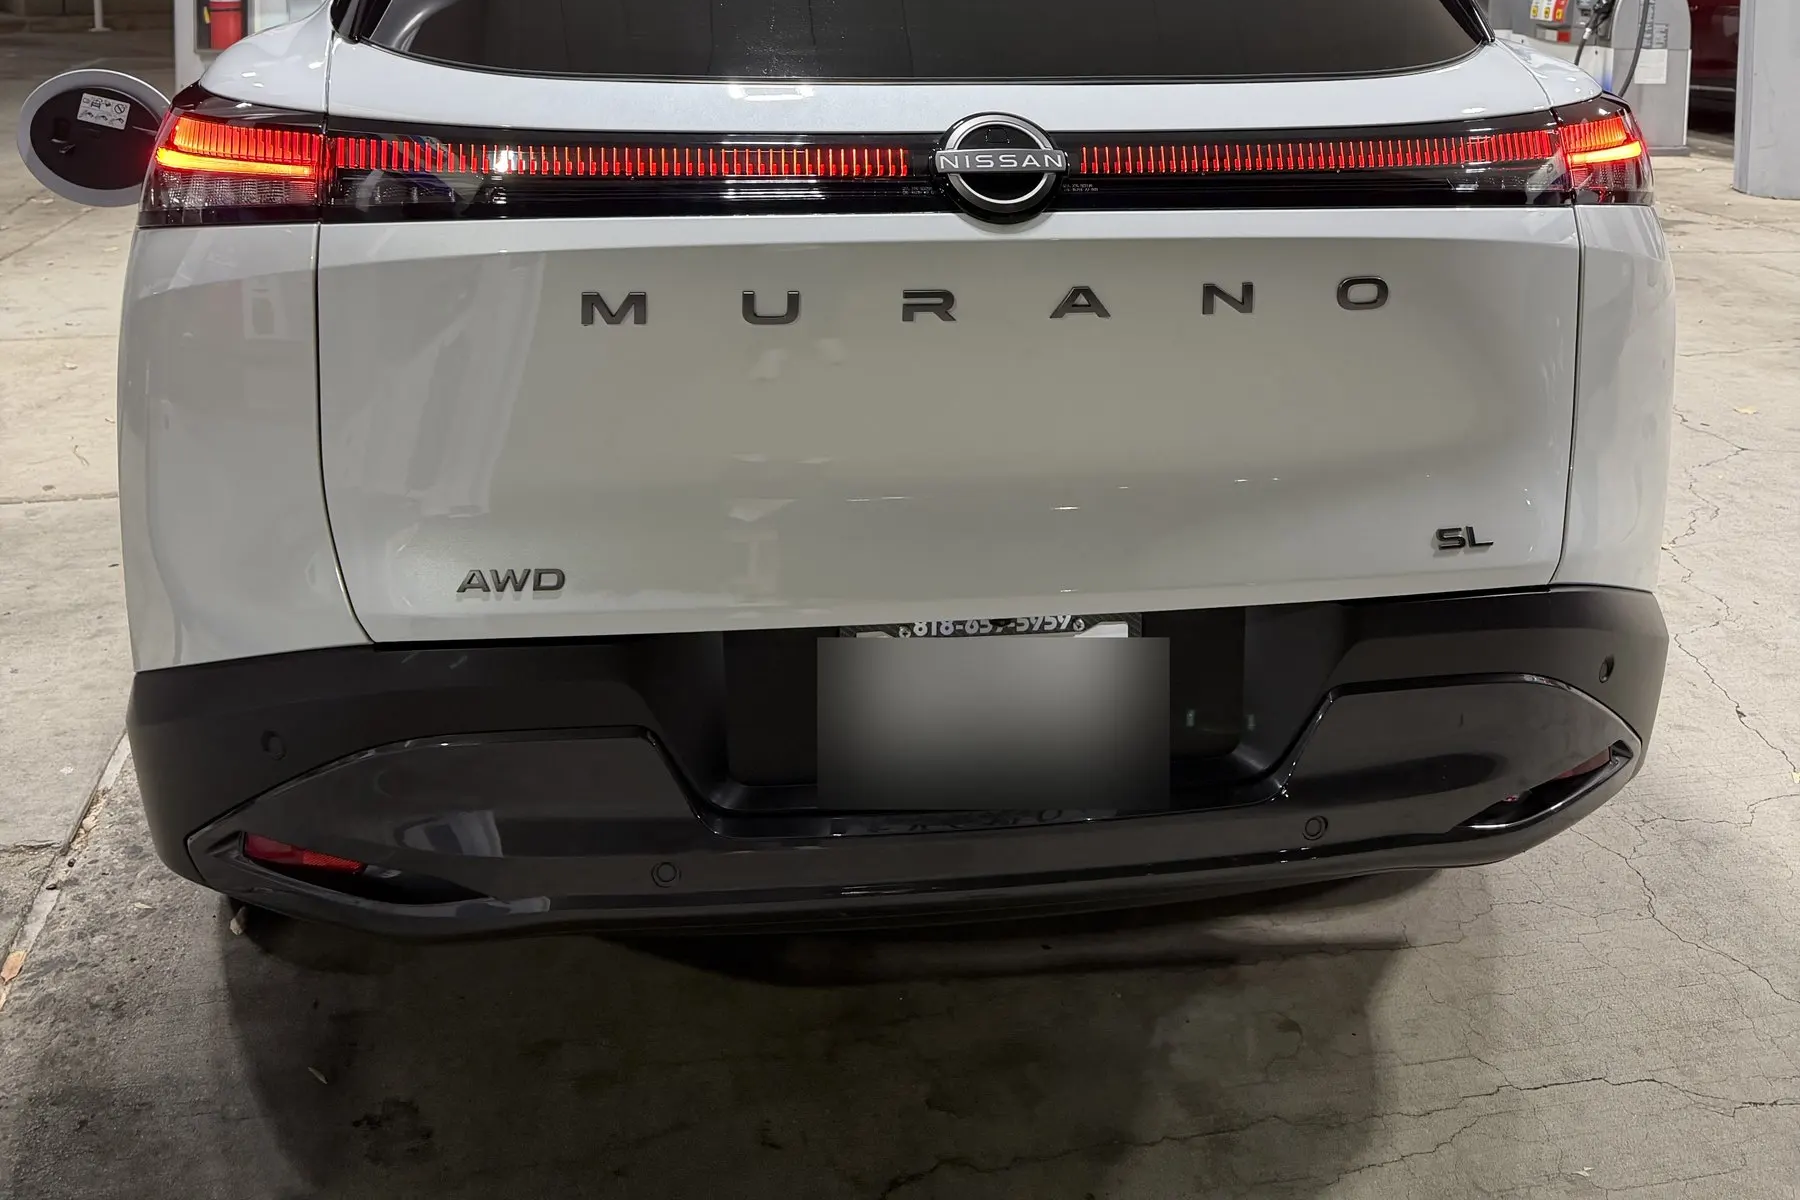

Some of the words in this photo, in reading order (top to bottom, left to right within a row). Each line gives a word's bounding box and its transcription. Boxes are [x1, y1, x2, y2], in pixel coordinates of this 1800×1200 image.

[940, 154, 1063, 169] NISSAN
[581, 275, 1389, 326] MURANO
[1436, 526, 1494, 551] SL
[456, 568, 566, 593] AWD
